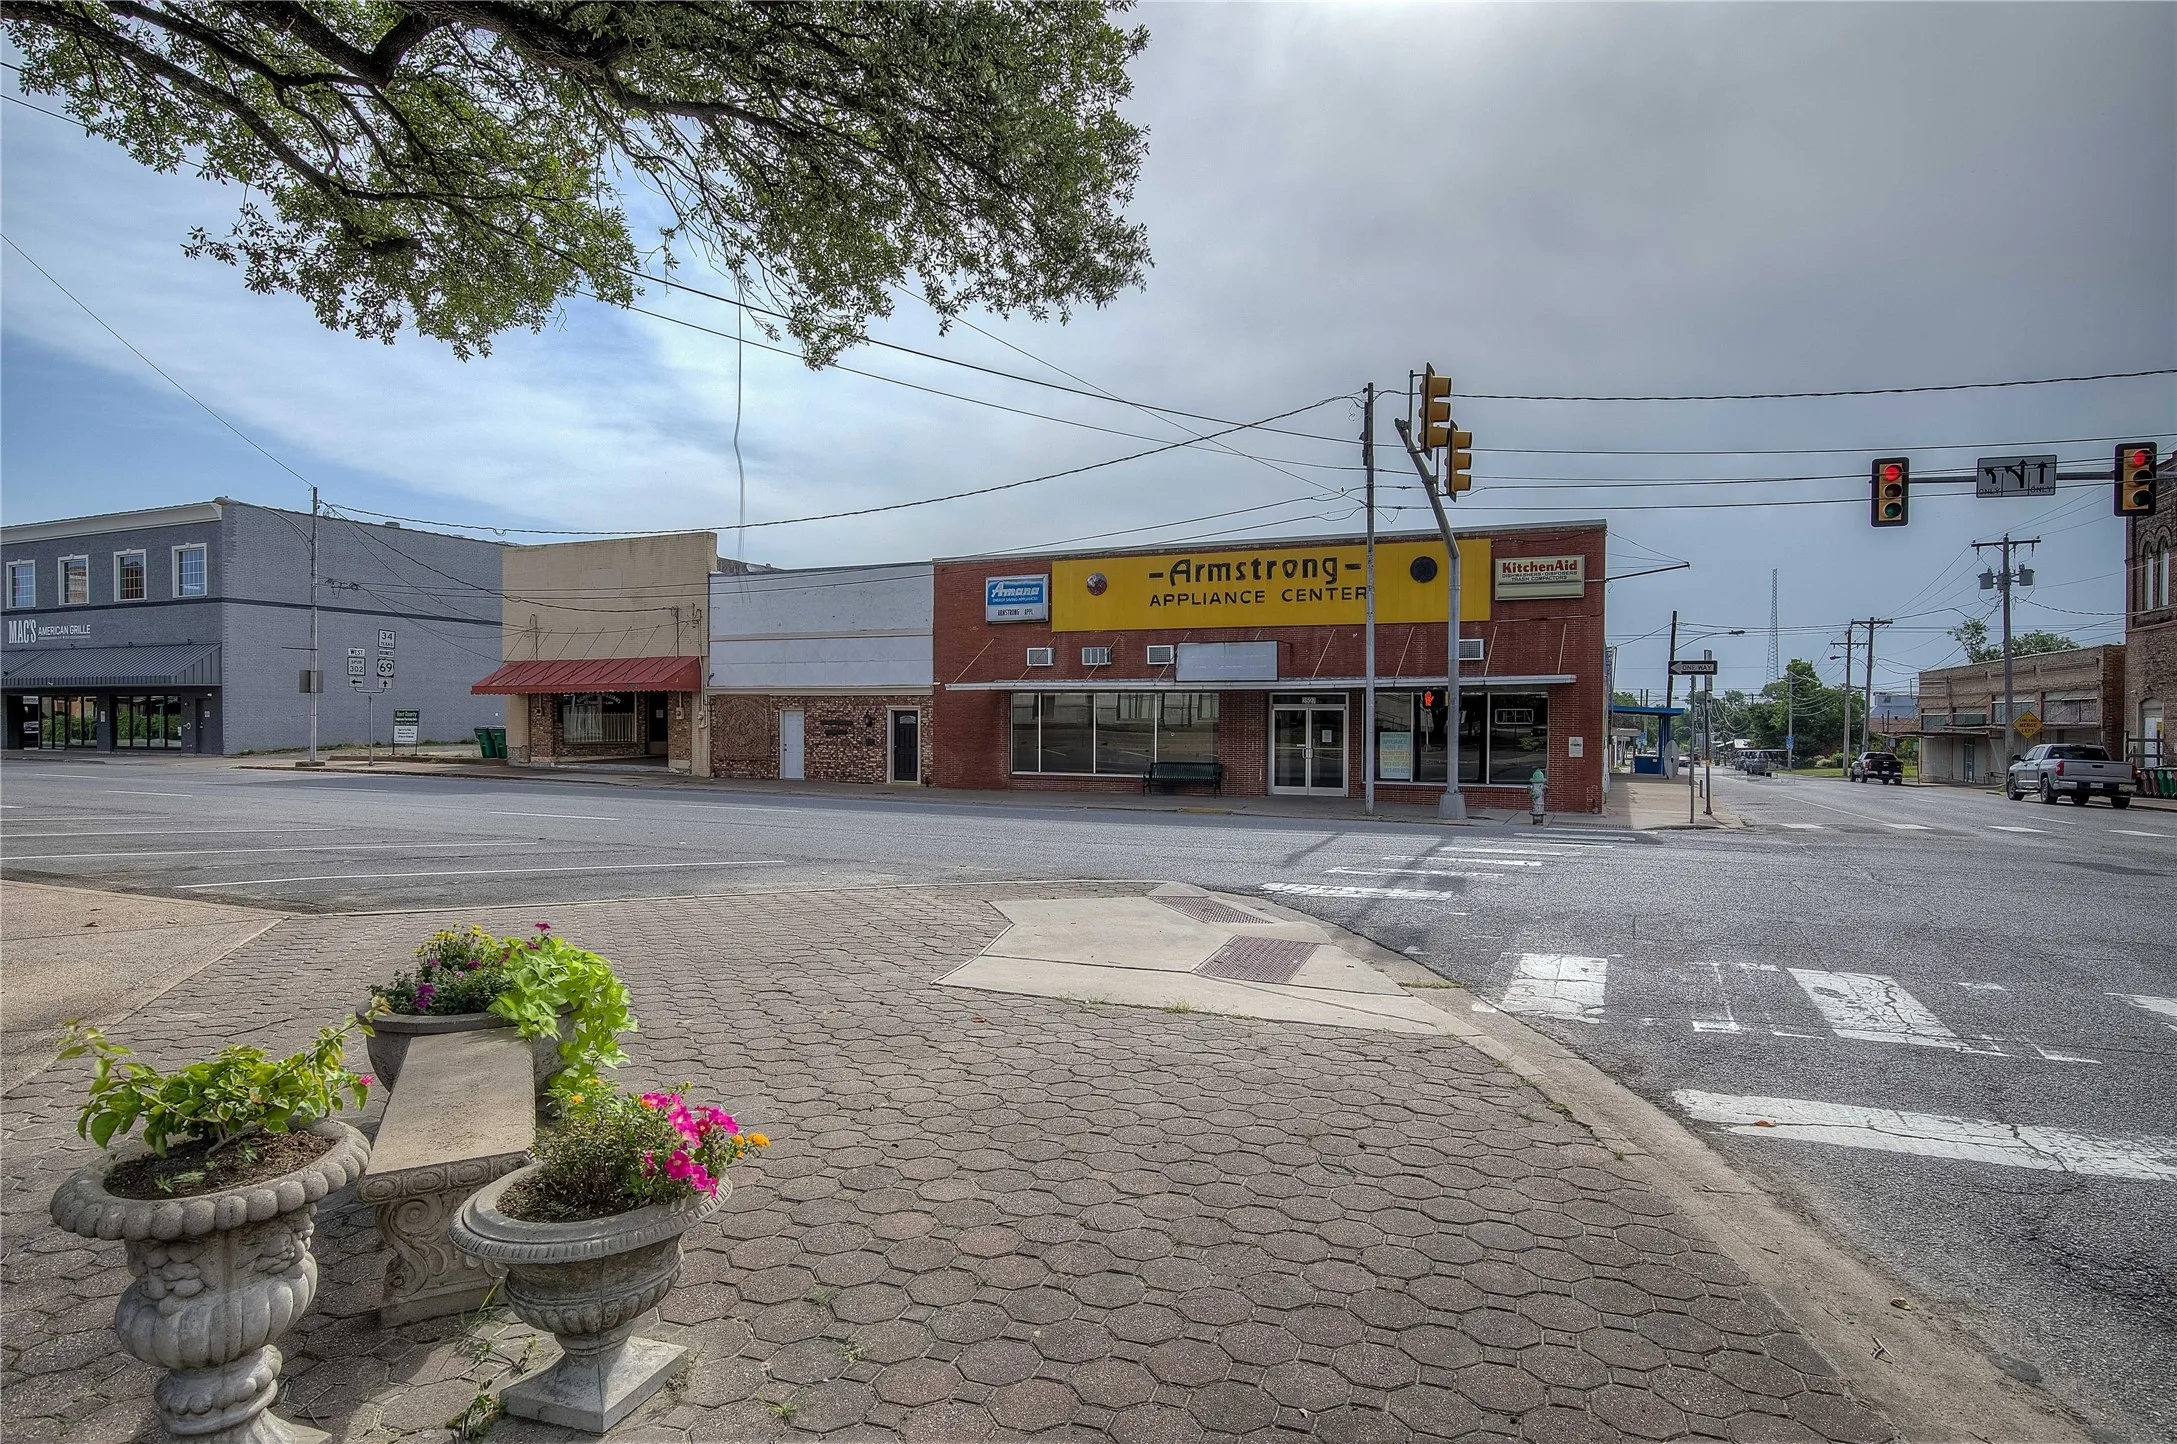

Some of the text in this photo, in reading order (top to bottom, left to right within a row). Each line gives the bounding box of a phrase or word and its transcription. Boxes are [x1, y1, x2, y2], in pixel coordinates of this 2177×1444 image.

[1979, 486, 2000, 495] ONLY
[2030, 484, 2052, 493] ONLY
[1502, 560, 1578, 573] KitchenAid
[991, 581, 1040, 597] Amana
[1150, 586, 1367, 607] APPLIANCE CENTER
[8, 620, 37, 644] MAC'S
[38, 624, 91, 636] AMERICAN GRILLE
[381, 632, 393, 640] 34
[379, 663, 393, 673] 69
[1496, 710, 1533, 723] OPEN
